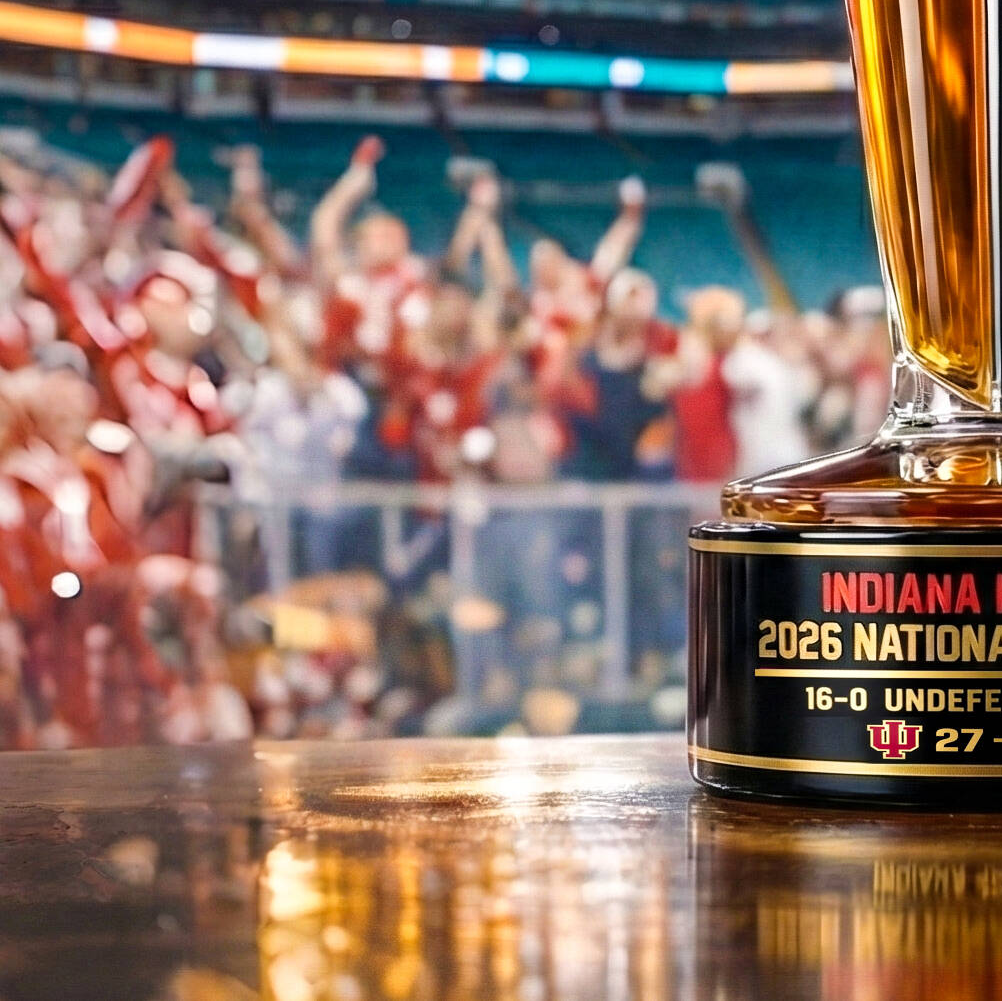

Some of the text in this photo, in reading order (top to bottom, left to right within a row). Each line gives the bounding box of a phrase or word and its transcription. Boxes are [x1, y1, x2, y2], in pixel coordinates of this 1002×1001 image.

[821, 572, 981, 615] INDIANA
[758, 620, 842, 661] 2026
[805, 687, 868, 711] 16-0
[935, 728, 983, 753] 27
